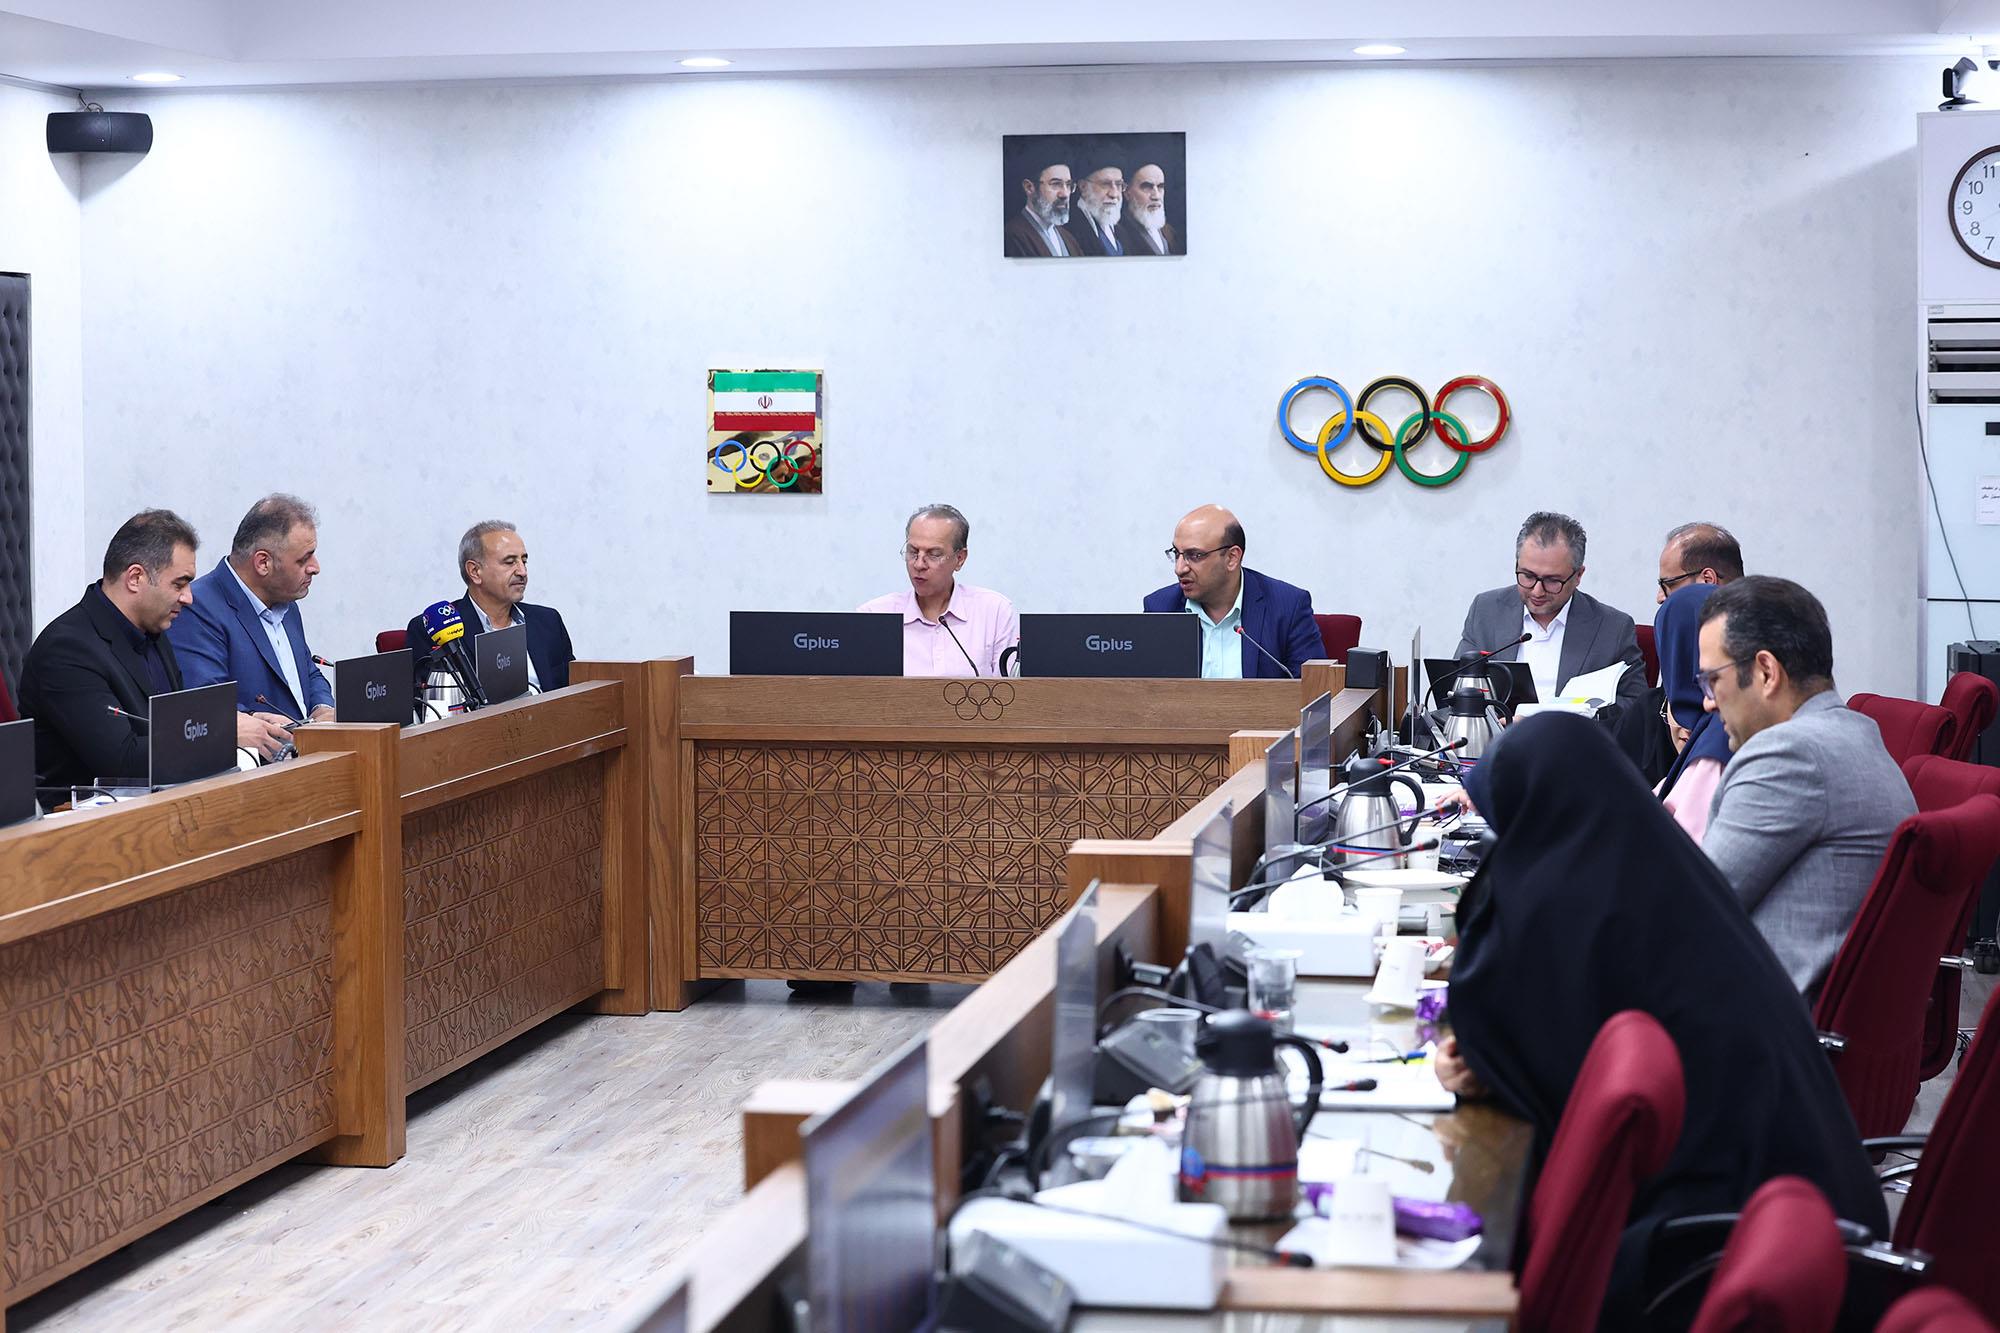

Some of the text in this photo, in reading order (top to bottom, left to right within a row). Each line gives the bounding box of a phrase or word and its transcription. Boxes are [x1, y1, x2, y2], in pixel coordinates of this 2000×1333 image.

[1983, 165, 1996, 179] 11
[1968, 181, 1984, 195] 10
[1962, 201, 1973, 216] 9
[1970, 221, 1981, 236] 8
[1985, 236, 1995, 250] 7
[793, 632, 840, 651] Gplus
[1085, 634, 1133, 653] Gplus
[496, 652, 511, 671] Gplus
[365, 680, 387, 701] Gplus
[184, 718, 208, 742] Gplus
